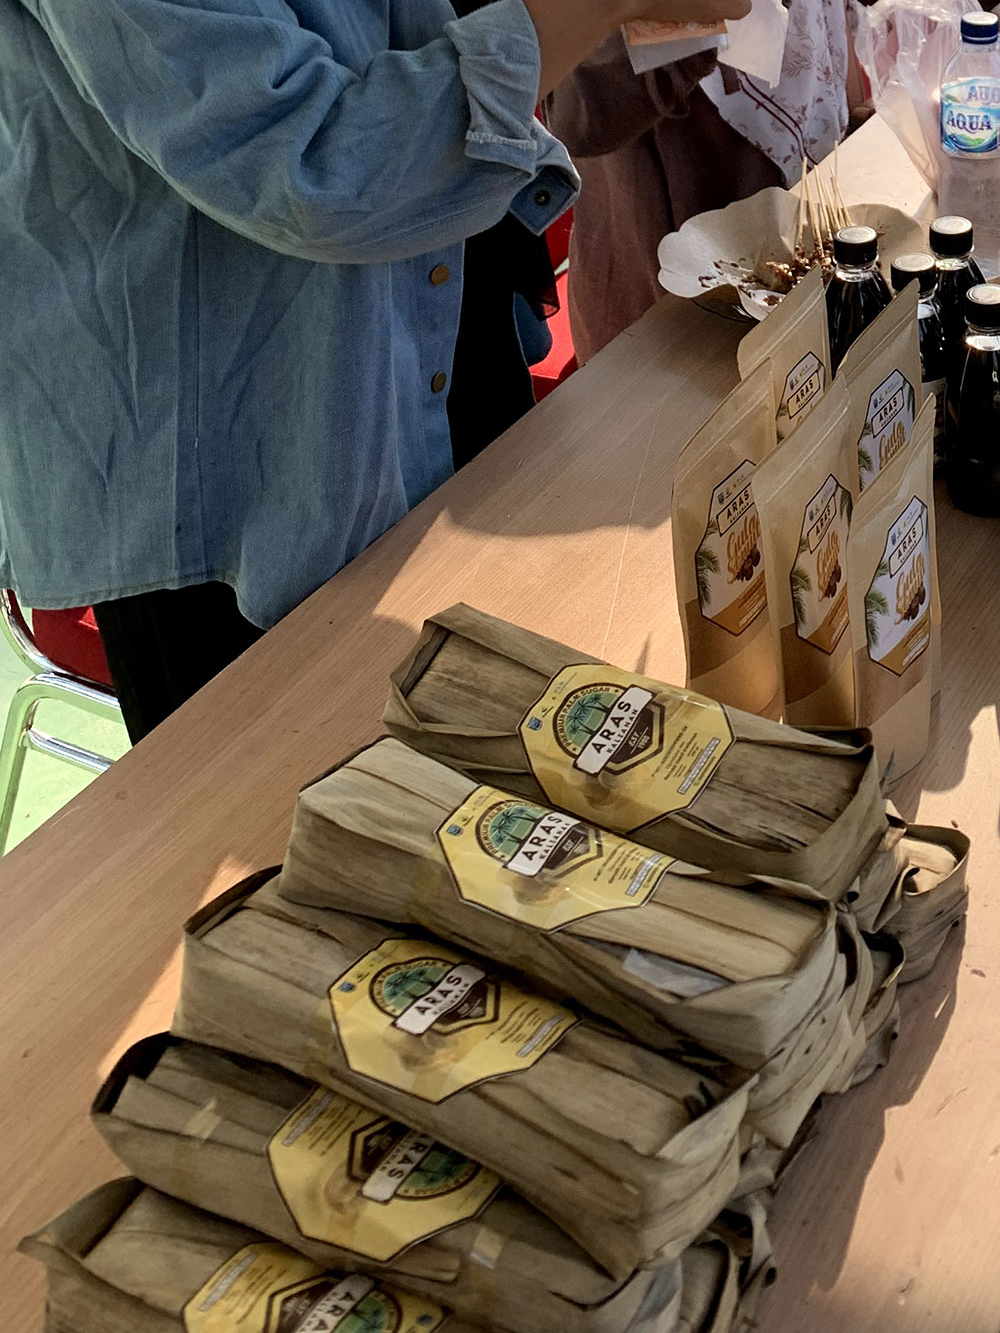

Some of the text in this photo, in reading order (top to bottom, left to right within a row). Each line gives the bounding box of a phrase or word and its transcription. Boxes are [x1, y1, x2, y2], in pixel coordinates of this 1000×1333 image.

[947, 110, 993, 134] AQUA
[795, 379, 814, 403] ARAS
[879, 397, 898, 422] ARAS
[726, 489, 750, 520] ARAS
[897, 527, 917, 561] ARAS
[592, 700, 632, 754] ARAS
[522, 815, 564, 861] ARAS
[415, 973, 463, 1016] ARAS
